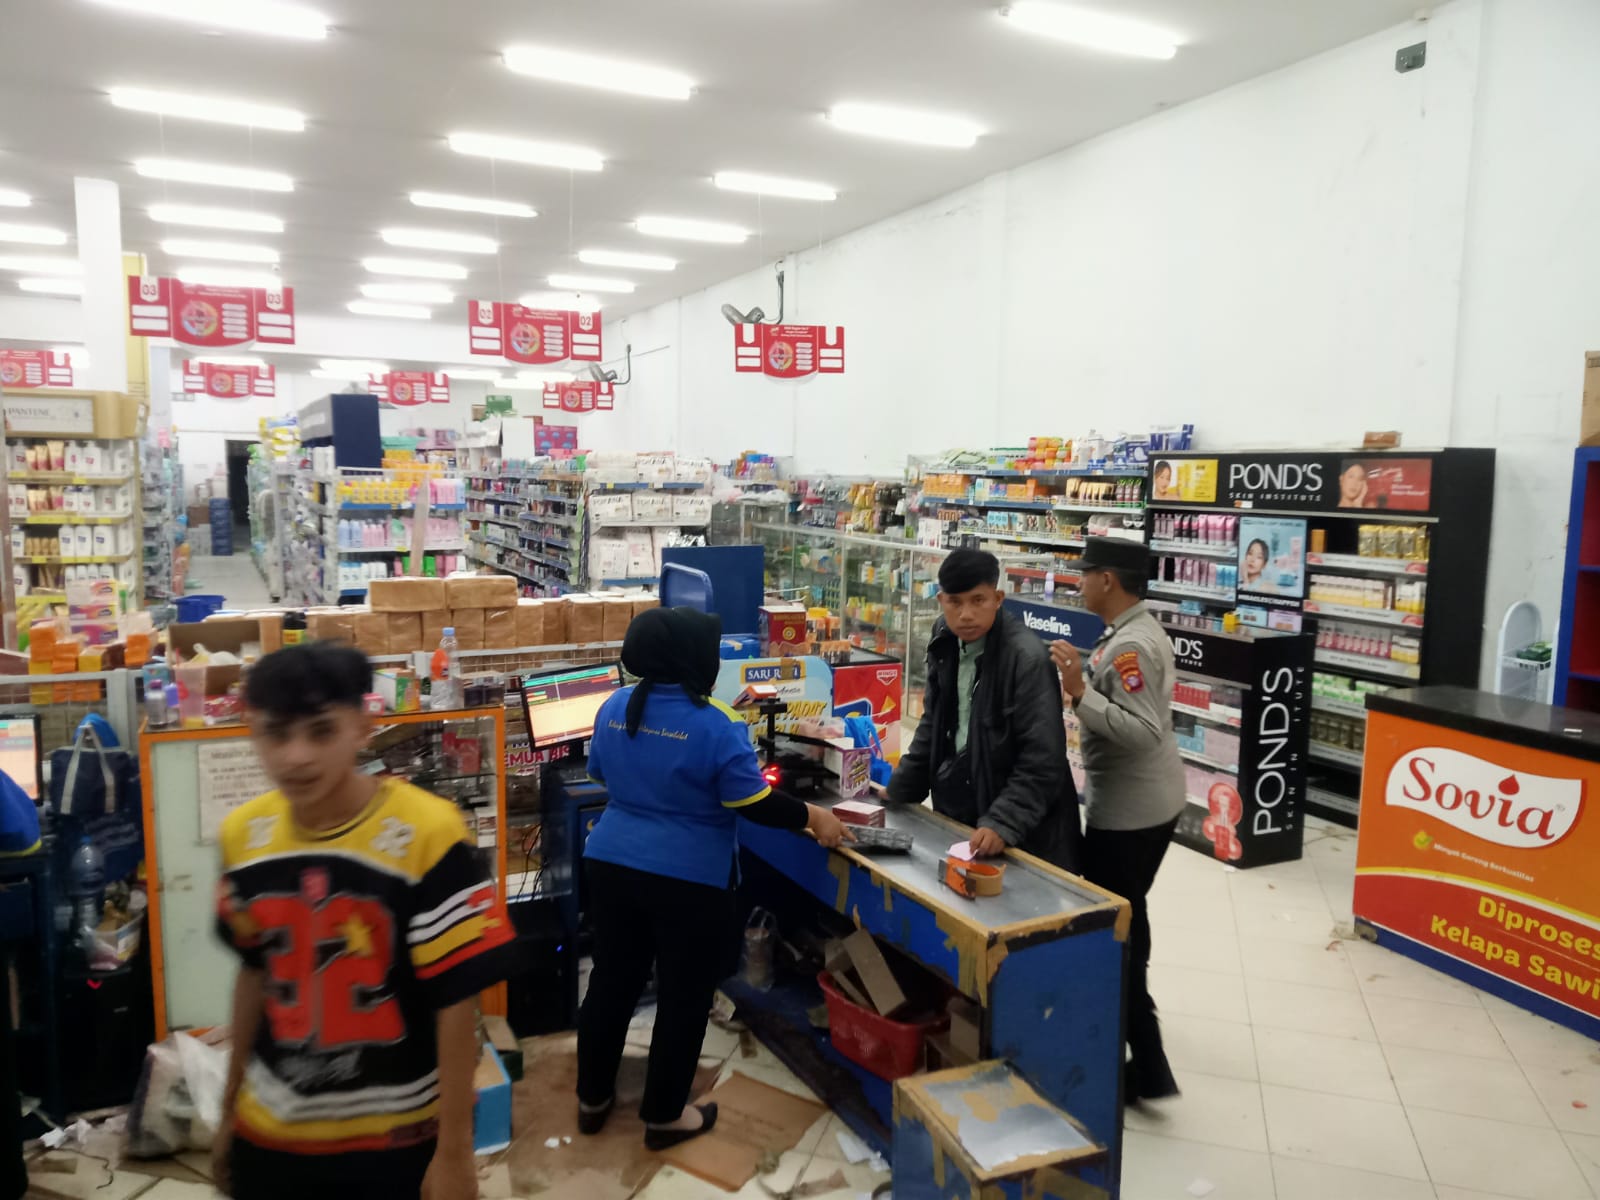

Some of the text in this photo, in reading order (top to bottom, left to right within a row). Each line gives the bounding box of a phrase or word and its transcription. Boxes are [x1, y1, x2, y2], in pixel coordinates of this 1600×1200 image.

[142, 284, 158, 297] 03
[267, 294, 282, 305] 03
[580, 315, 592, 327] 02
[1228, 462, 1324, 492] POND'S
[1228, 492, 1322, 502] SKIN INSTITUTE
[1022, 610, 1072, 637] Vaseline
[1167, 635, 1203, 660] ND'S
[747, 665, 798, 681] SARI RI
[504, 749, 545, 769] EMUA
[1253, 666, 1294, 836] POND'S
[1285, 786, 1296, 830] SKIN
[1402, 757, 1556, 841] Sovia
[1460, 852, 1489, 868] Goreng
[1430, 914, 1521, 968] Kelapa
[250, 892, 406, 1048] 32
